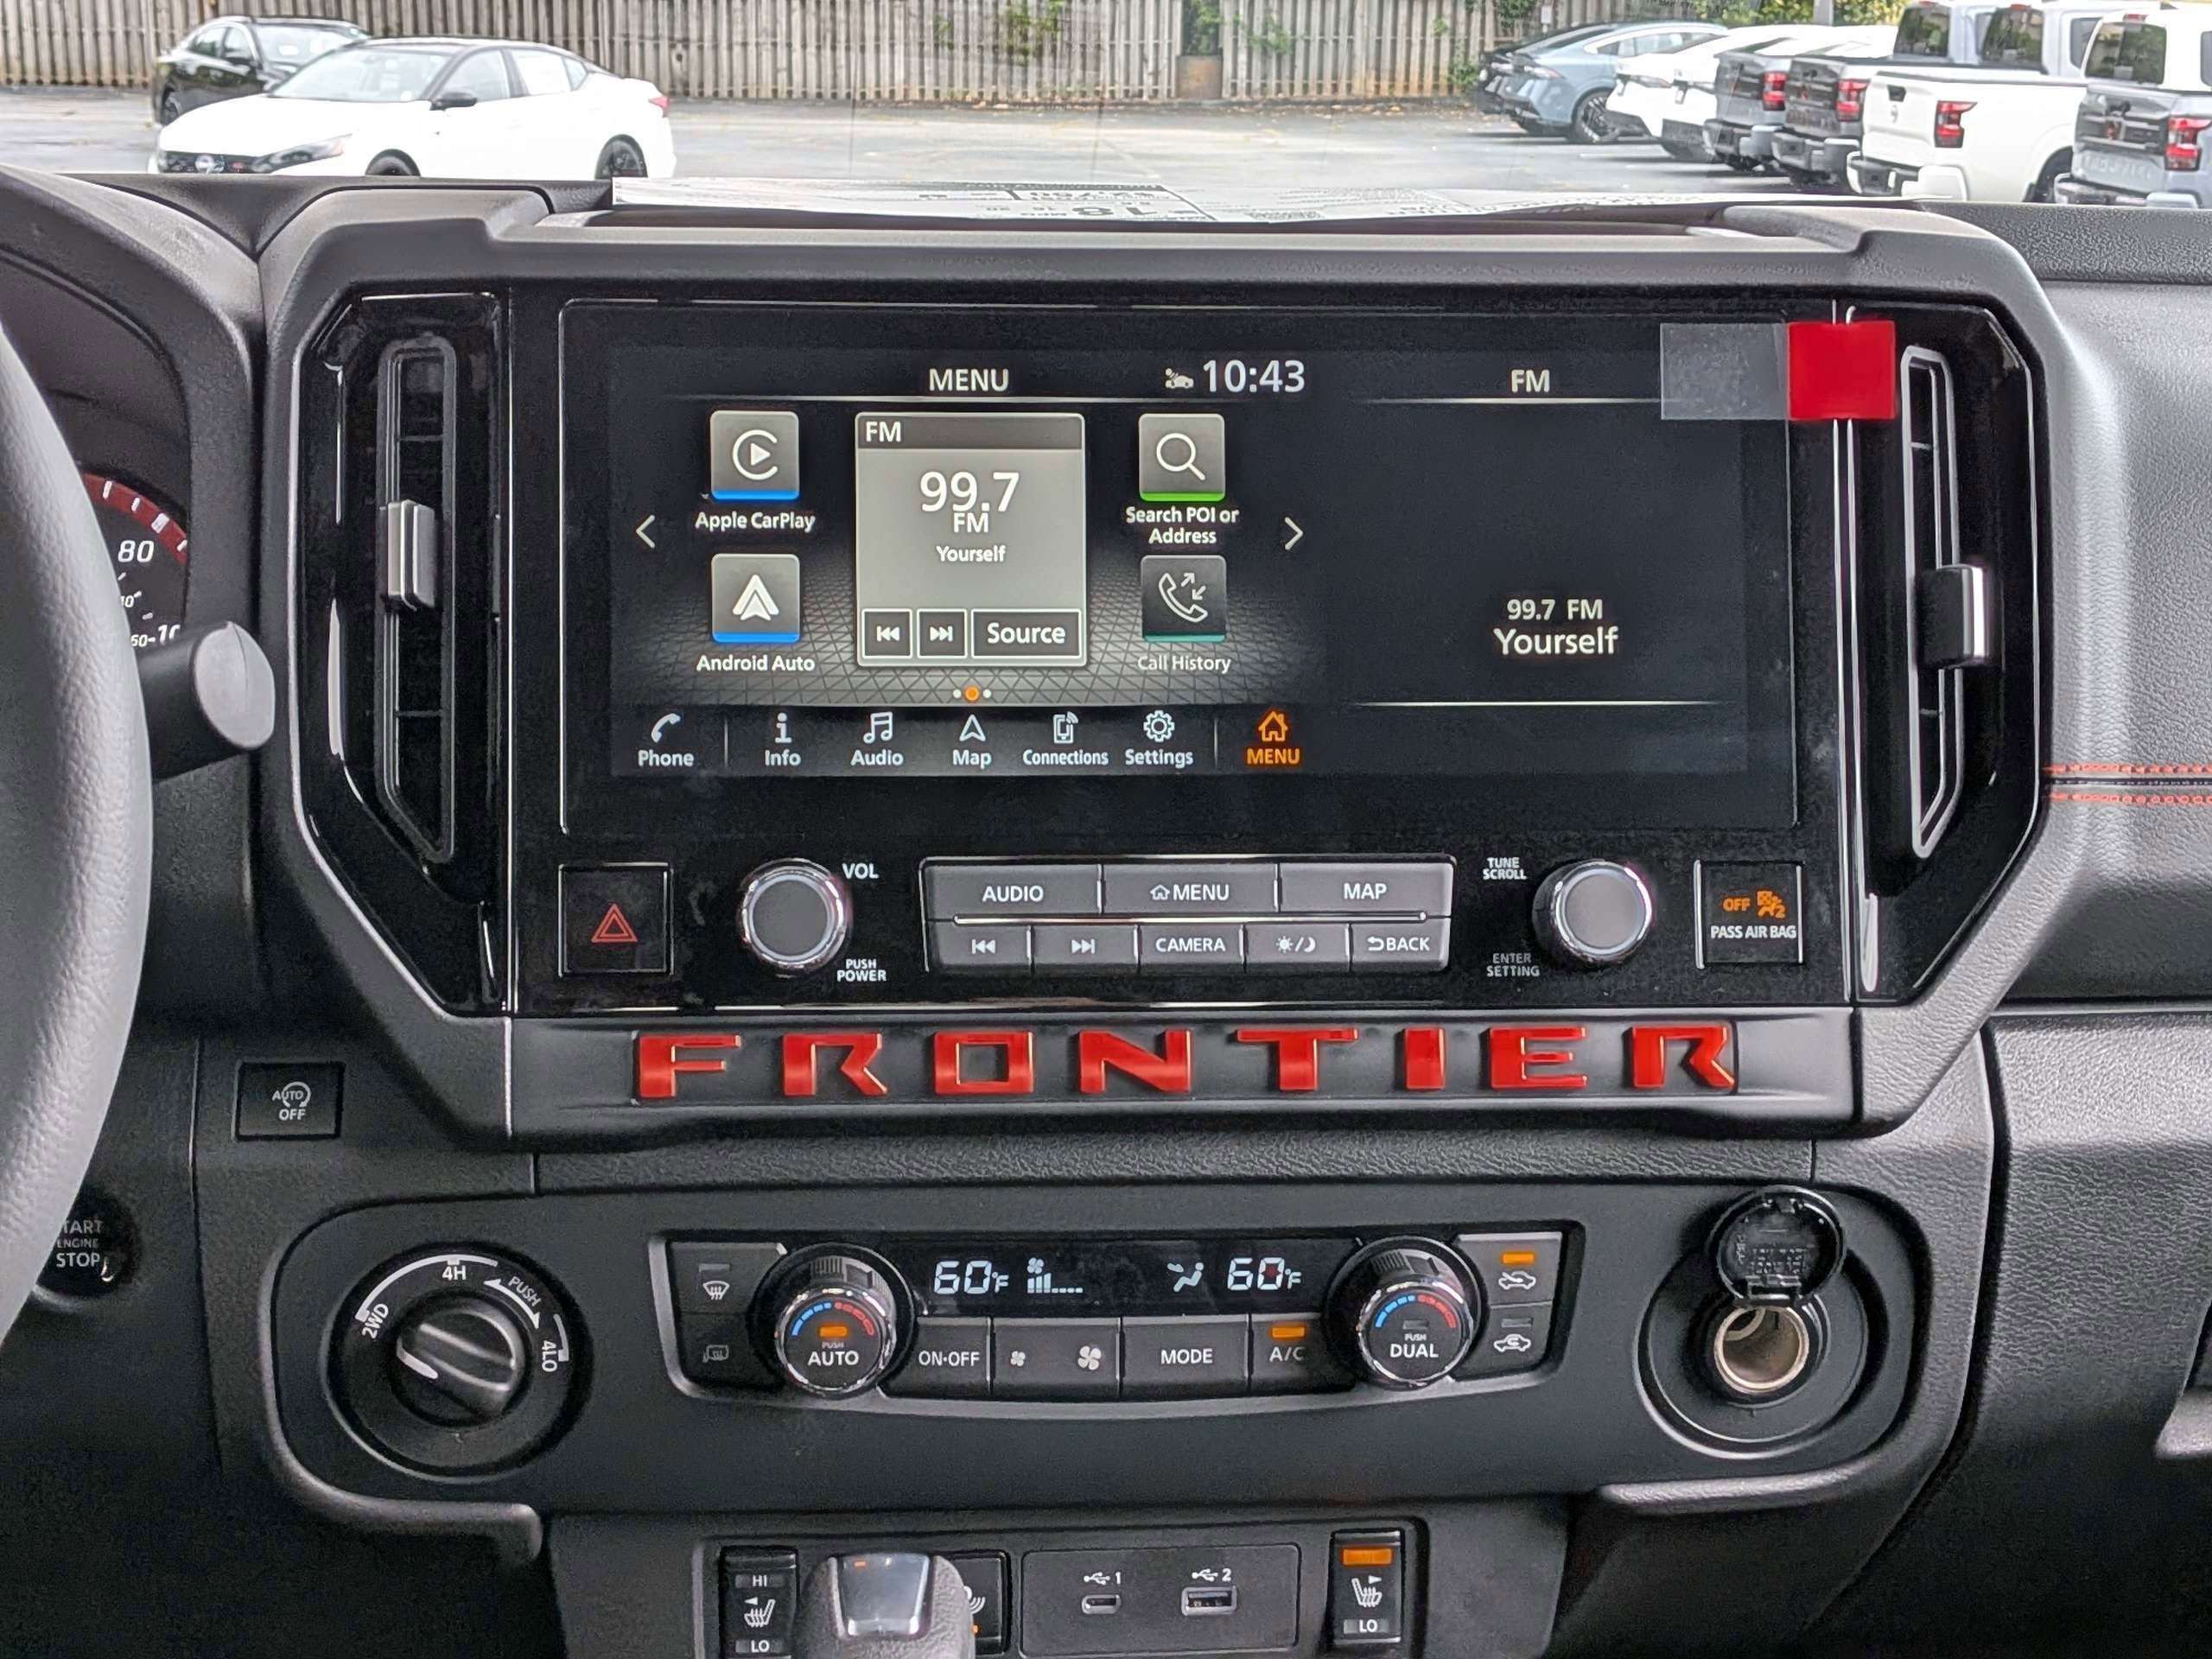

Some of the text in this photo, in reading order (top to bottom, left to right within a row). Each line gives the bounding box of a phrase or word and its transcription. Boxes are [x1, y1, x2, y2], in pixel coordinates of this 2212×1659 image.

[929, 368, 1009, 391] MENU
[1203, 359, 1305, 393] 10:43
[1511, 369, 1550, 393] FM
[866, 421, 901, 442] FM
[920, 471, 1020, 512] 99.7
[695, 511, 816, 533] Apple CarPlay
[953, 512, 989, 533] FM
[1125, 505, 1240, 524] Search POI or
[1148, 526, 1217, 544] Address
[118, 539, 155, 563] 80
[936, 544, 1006, 563] Yourself
[1507, 599, 1603, 620] 99.7 FM
[987, 622, 1066, 644] Source
[1493, 626, 1618, 655] Yourself
[696, 653, 816, 671] Android Auto
[1137, 652, 1231, 674] Call History
[638, 748, 1194, 770] Phone Info Audio Map Connections Settings
[1247, 748, 1300, 765] MENU
[842, 862, 880, 880] VOL
[1486, 856, 1520, 869] TUNE
[1482, 868, 1528, 880] SCROLL
[982, 885, 1044, 902] AUDIO
[1173, 884, 1230, 901] MENU
[1344, 882, 1388, 899] MAP
[1722, 897, 1751, 912] OFF
[1710, 925, 1797, 939] PASS AIR BAG
[1155, 938, 1226, 952] CAMERA
[1386, 937, 1430, 951] BACK
[845, 958, 877, 969] PUSH
[1492, 952, 1532, 964] ENTER
[836, 967, 887, 982] POWER
[1486, 962, 1541, 977] SETTING
[637, 1027, 1736, 1094] FRONTIER
[271, 1089, 305, 1102] AUTO
[278, 1108, 306, 1121] OFF
[63, 1218, 105, 1234] TART
[55, 1237, 99, 1249] ENGINE
[54, 1250, 102, 1268] STOP
[441, 1264, 471, 1281] 4H
[507, 1275, 542, 1307] PUSH
[361, 1303, 390, 1340] 2WD
[540, 1339, 558, 1374] 4LO
[807, 1350, 860, 1366] AUTO
[1160, 1348, 1213, 1364] MODE
[1268, 1346, 1301, 1363] A/C
[1389, 1343, 1439, 1358] DUAL
[750, 1573, 769, 1588] HI
[1115, 1571, 1122, 1585] 1
[1222, 1567, 1232, 1582] 2
[1358, 1618, 1379, 1633] LO
[749, 1639, 772, 1654] LO
